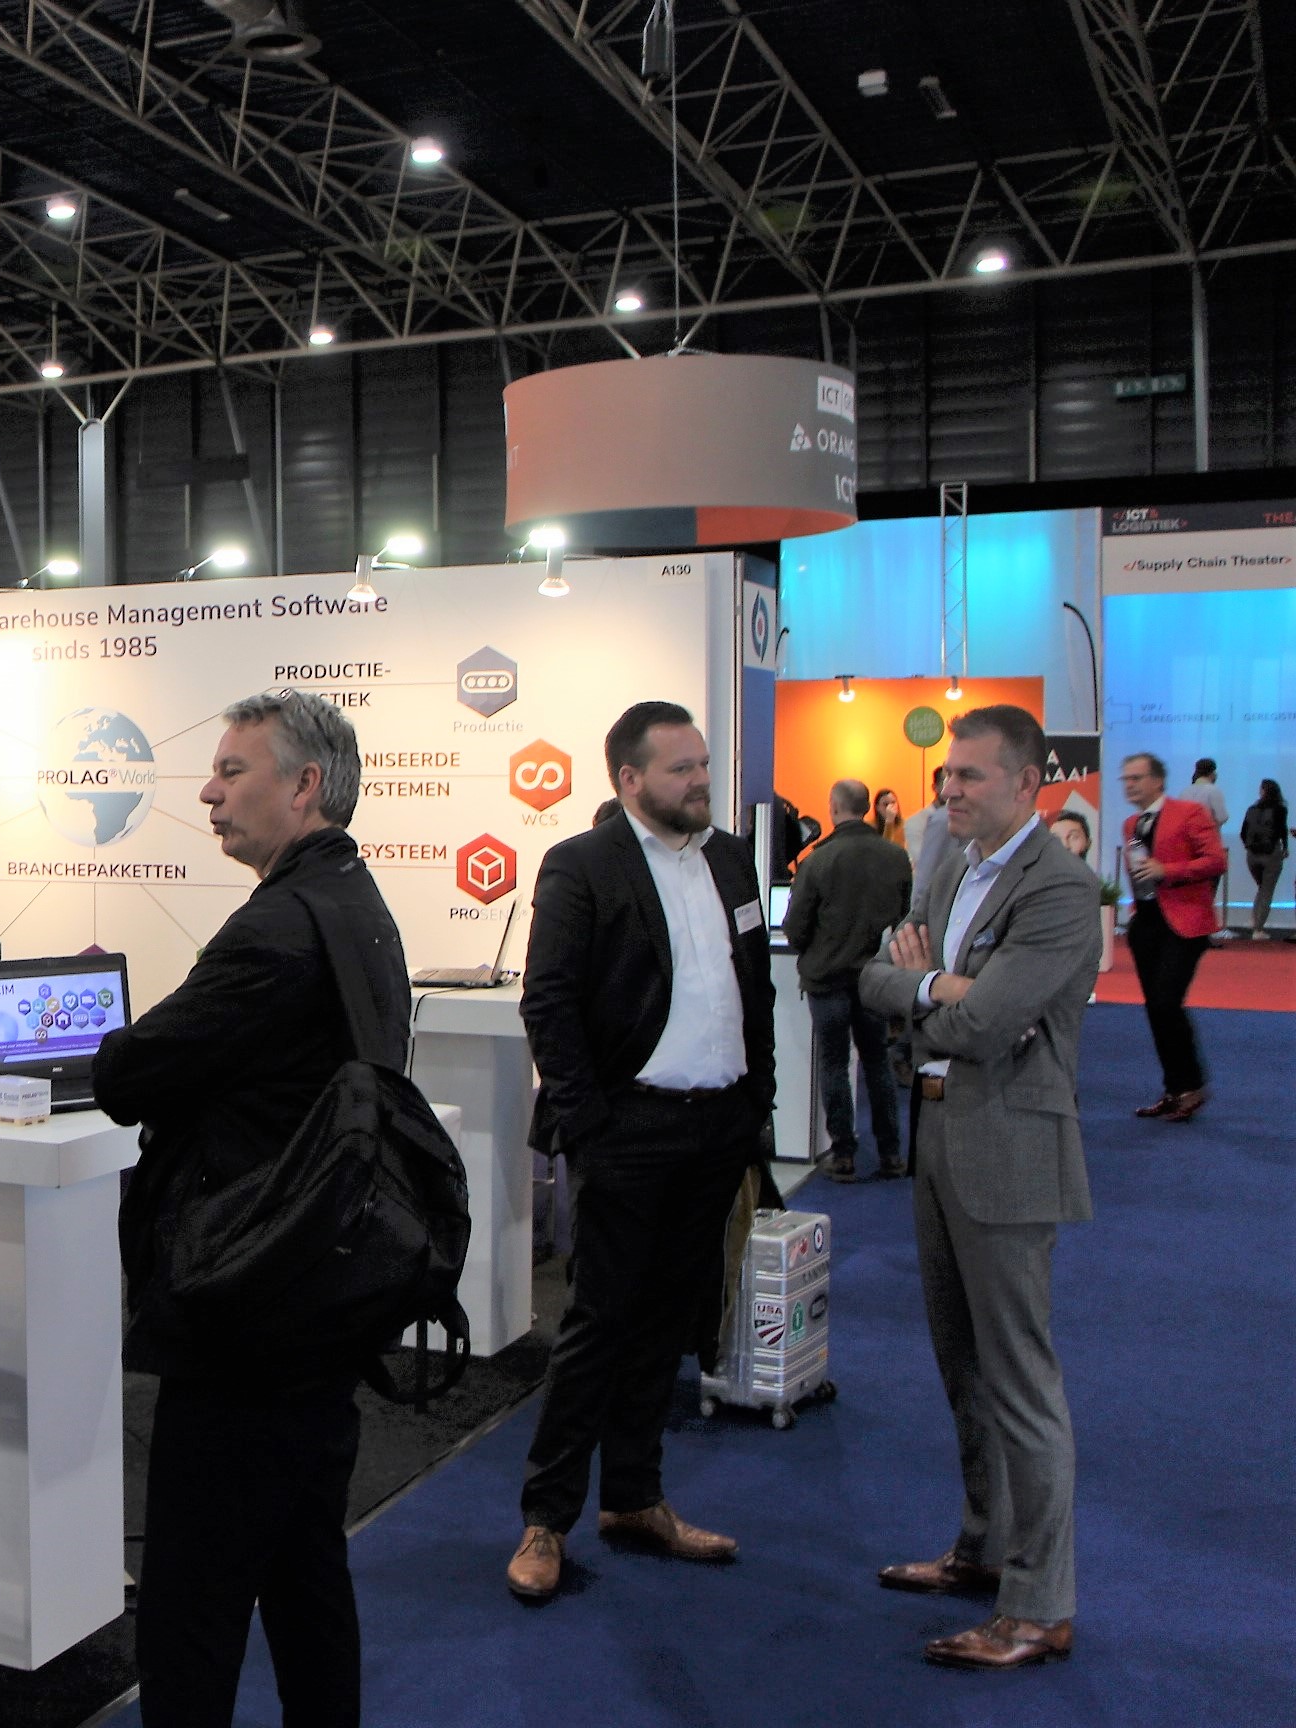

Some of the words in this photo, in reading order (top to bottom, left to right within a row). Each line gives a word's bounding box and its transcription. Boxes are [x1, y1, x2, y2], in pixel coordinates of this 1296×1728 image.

[1187, 555, 1227, 569] Chain
[661, 564, 692, 577] A130
[107, 600, 263, 627] Management
[271, 594, 389, 617] Software
[31, 640, 90, 663] sinds
[100, 636, 158, 659] 1985
[274, 662, 391, 680] PRODUCTIE-
[320, 691, 372, 708] TIEK
[453, 719, 524, 733] Productie
[361, 752, 461, 768] NISEERDE
[359, 781, 450, 797] YSTEMEN
[522, 813, 560, 827] WCS
[360, 843, 448, 860] SYSTEEM
[8, 861, 188, 880] BRANCHEPAKKETTEN
